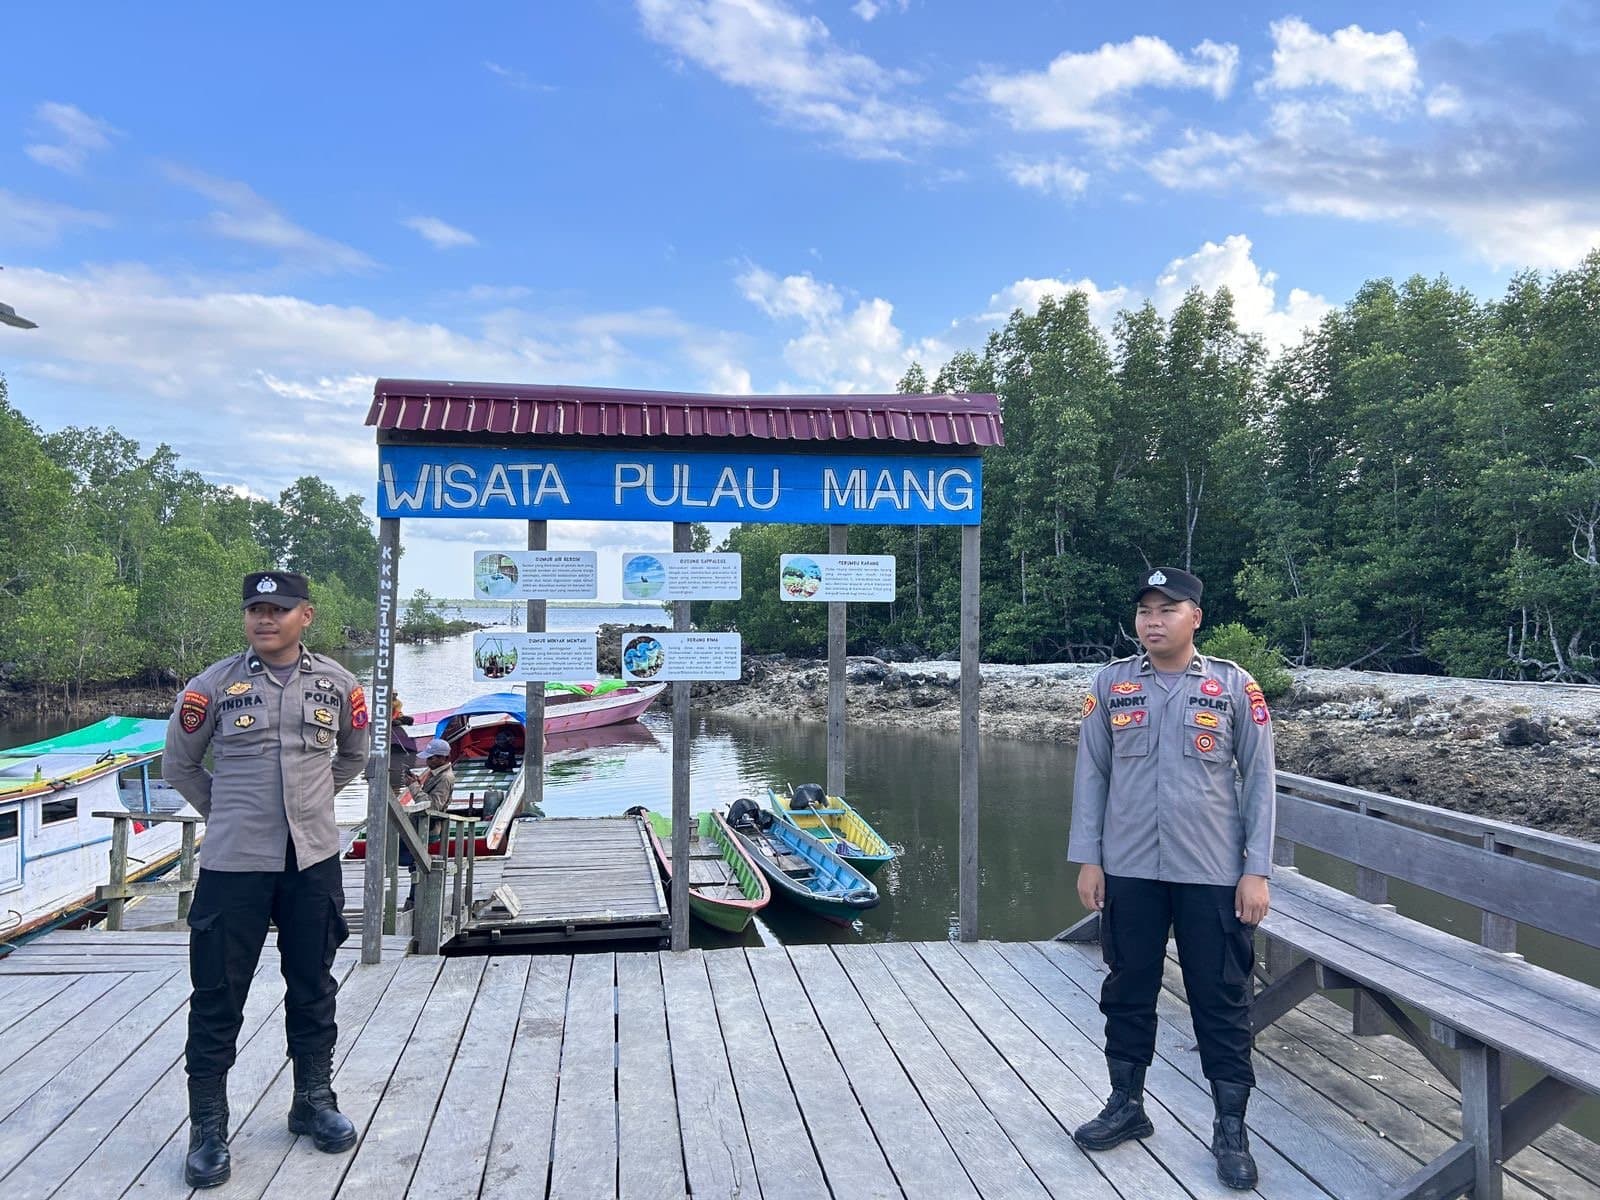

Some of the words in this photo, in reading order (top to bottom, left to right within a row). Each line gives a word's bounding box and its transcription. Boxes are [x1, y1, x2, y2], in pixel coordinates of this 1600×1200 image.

[382, 463, 570, 511] WISATA
[614, 463, 780, 509] PULAU
[822, 466, 974, 512] MIANG
[222, 694, 263, 712] INDRA
[304, 691, 339, 707] POLRI
[1109, 695, 1147, 709] ANDRY
[1189, 696, 1228, 712] POLRI
